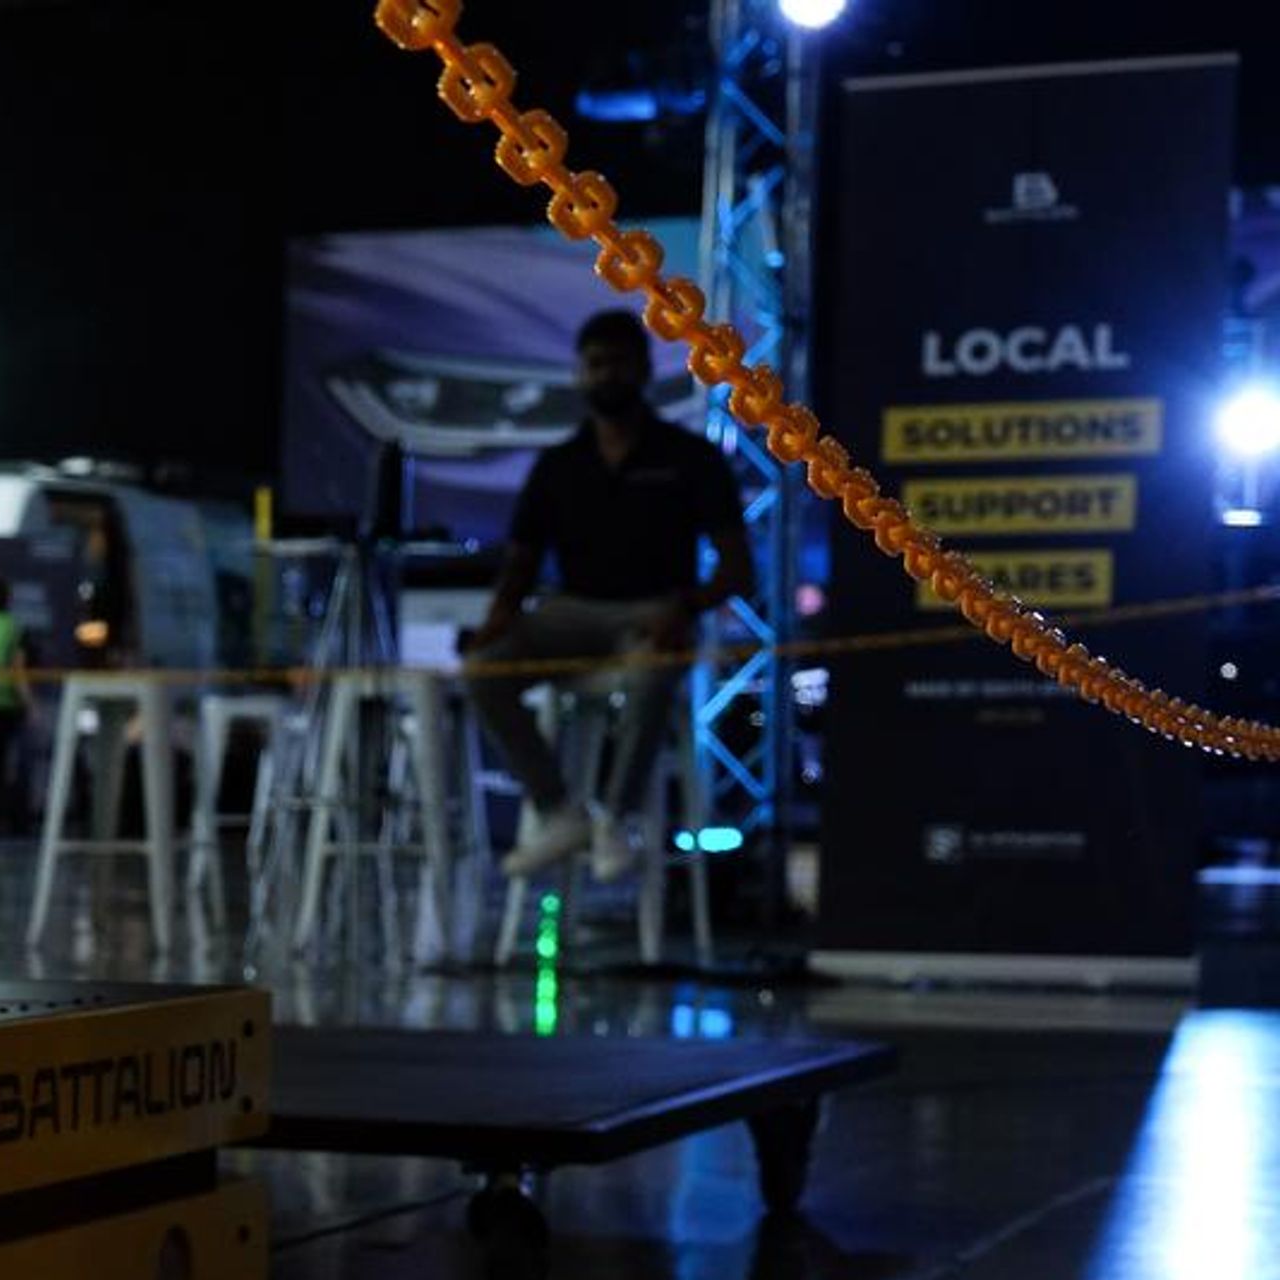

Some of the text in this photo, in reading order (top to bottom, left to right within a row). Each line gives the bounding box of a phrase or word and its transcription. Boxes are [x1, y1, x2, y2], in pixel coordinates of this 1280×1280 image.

[920, 323, 1131, 377] LOCAL
[903, 414, 1140, 448] SOLUTIONS
[918, 488, 1116, 522] SUPPORT
